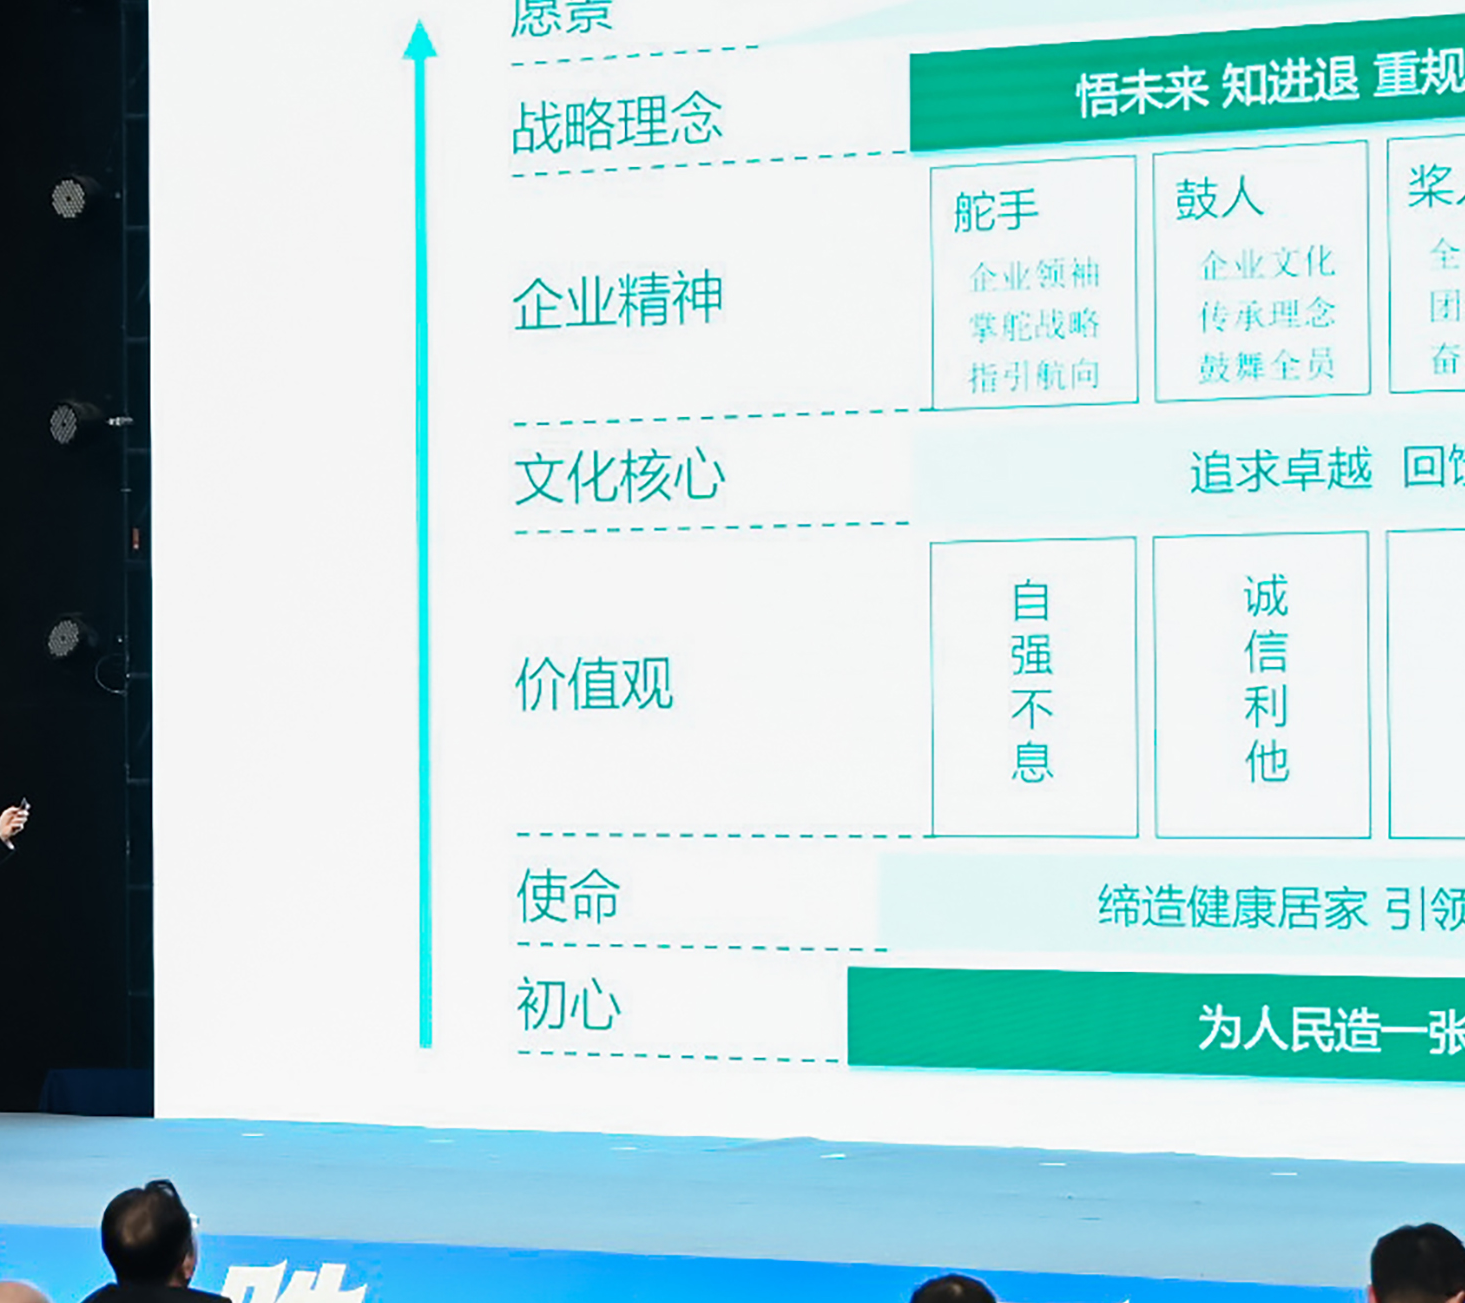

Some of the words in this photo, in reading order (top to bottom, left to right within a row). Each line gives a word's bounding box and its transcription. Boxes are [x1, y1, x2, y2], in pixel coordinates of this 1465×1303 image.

[1074, 60, 1211, 122] 悟未来
[1220, 55, 1361, 108] 知进退
[513, 90, 722, 154] 战略理念
[955, 188, 1038, 232] 舵手
[1177, 175, 1264, 220] 鼓人
[974, 258, 1099, 291] 企业领袖
[1204, 245, 1335, 280] 企业文化
[513, 269, 721, 330] 企业精神
[1202, 297, 1335, 333] 传承理念
[970, 307, 1099, 343] 掌舵战略
[970, 359, 1098, 394] 指引航向
[1199, 347, 1334, 384] 鼓舞全员
[515, 446, 725, 505] 文化核心
[1191, 445, 1373, 494] 追求卓越
[515, 656, 673, 711] 价值观
[1012, 579, 1053, 783] 自强不息
[1244, 574, 1289, 783] 诚信利他
[517, 868, 620, 924] 使命
[1098, 883, 1369, 930] 缔造健康居家
[518, 976, 621, 1031] 初心
